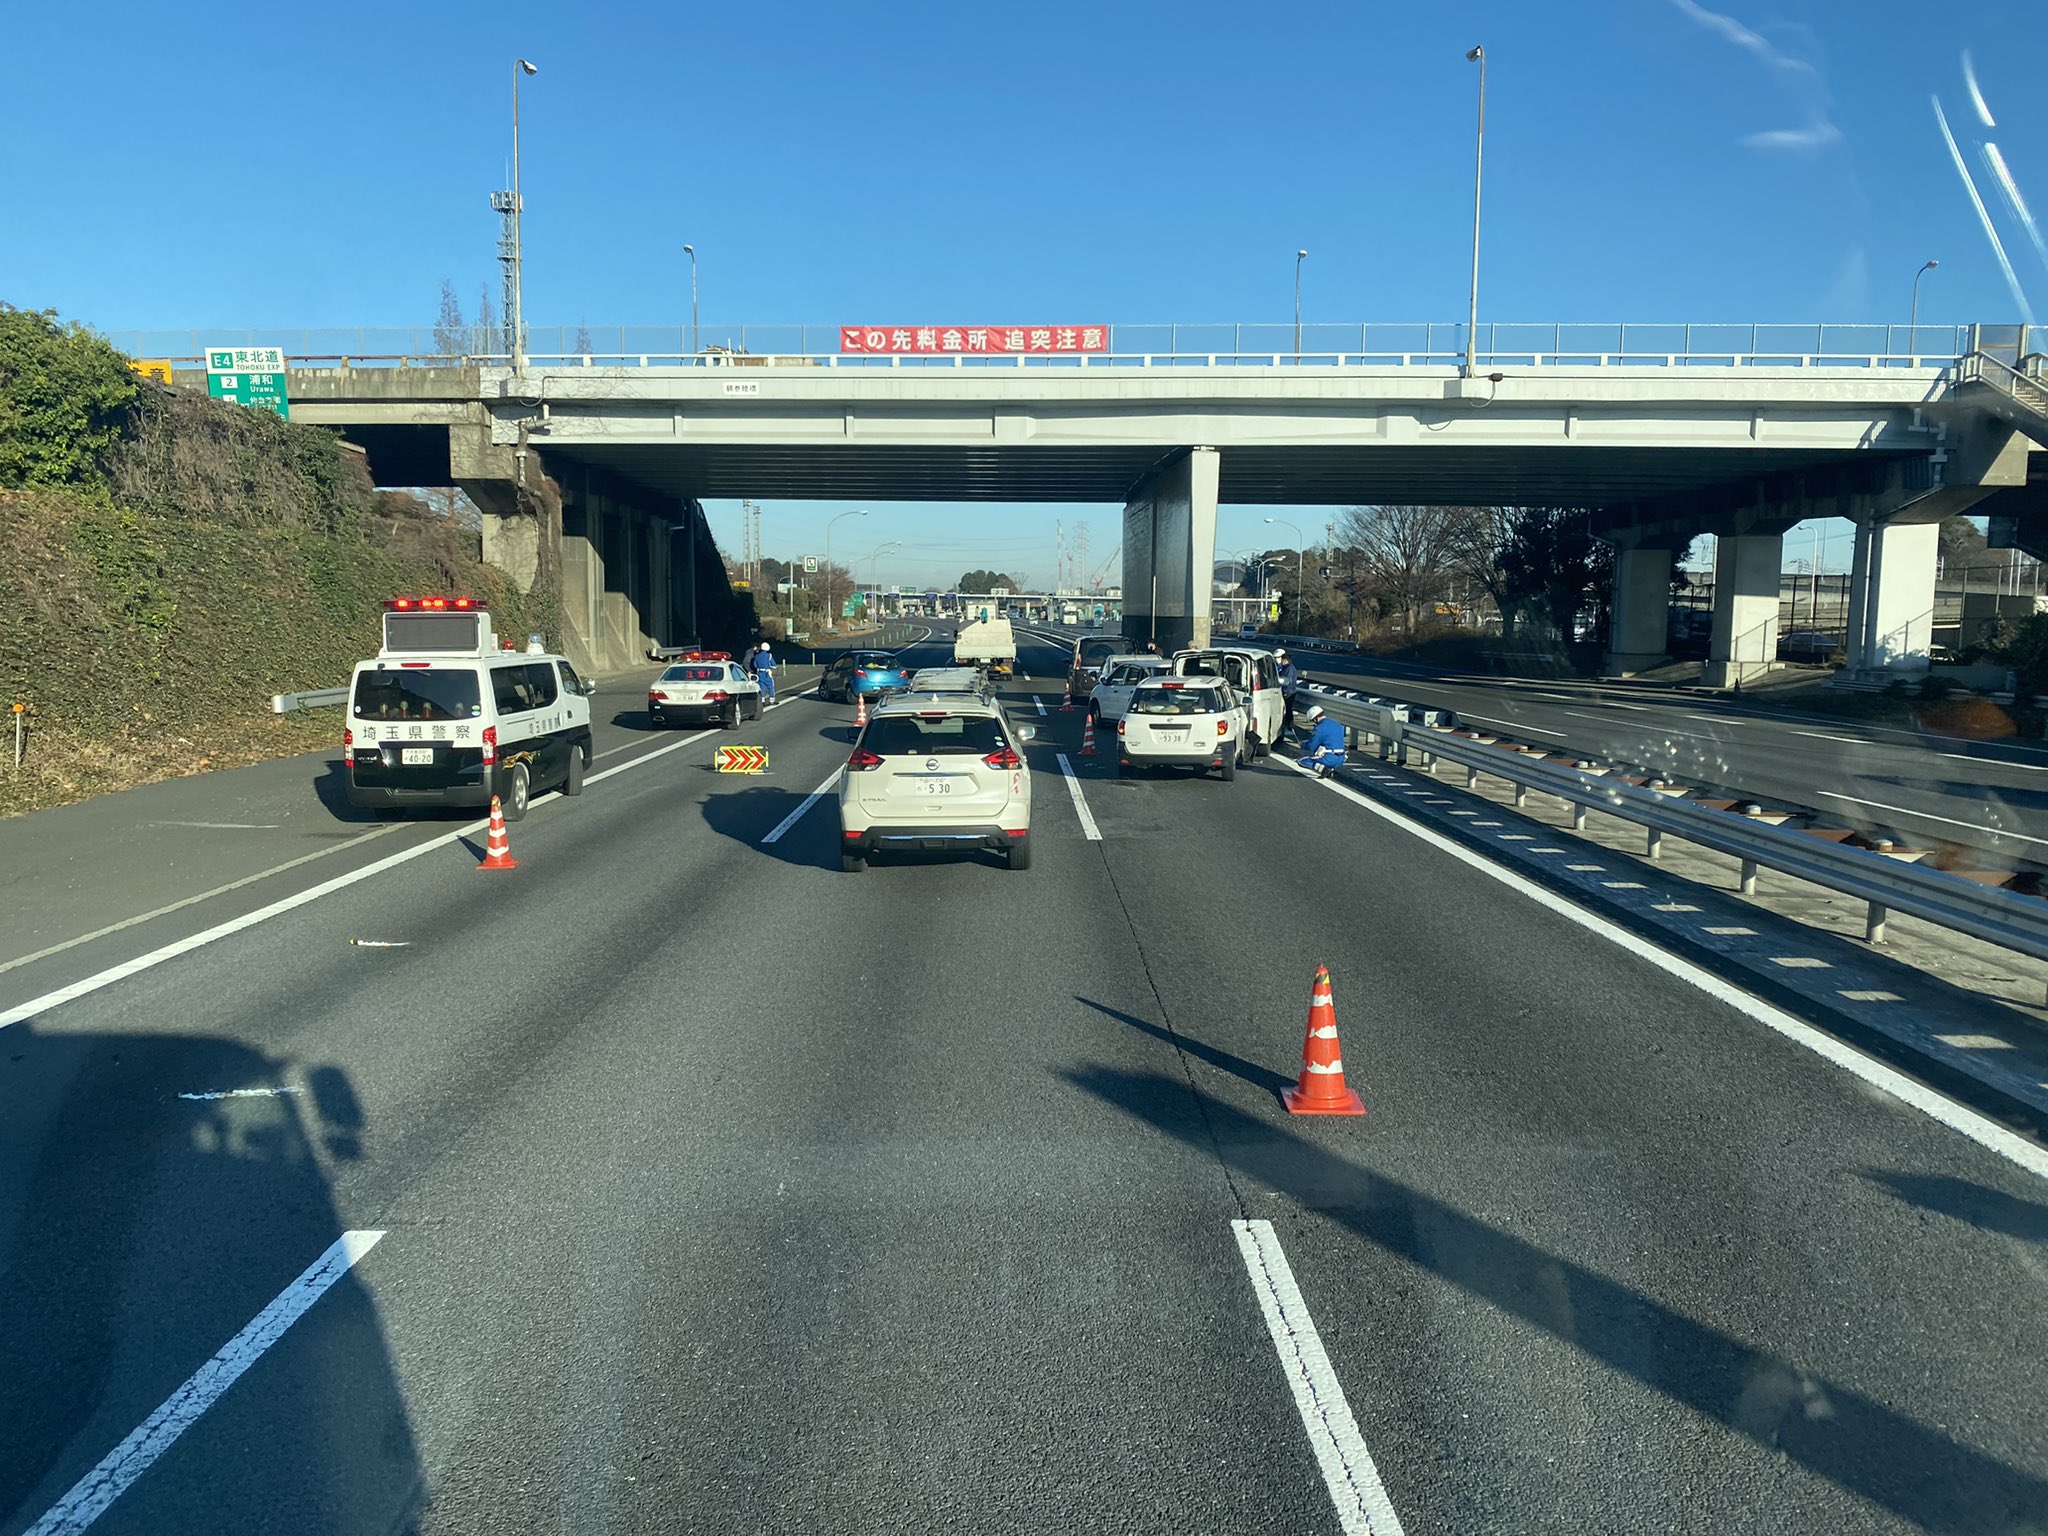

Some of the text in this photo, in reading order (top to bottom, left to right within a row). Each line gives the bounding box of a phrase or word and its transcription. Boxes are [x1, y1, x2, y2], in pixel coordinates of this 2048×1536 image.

[845, 328, 1102, 351] この先料金所 追突注意
[213, 355, 231, 366] E4
[235, 350, 279, 363] 東北道
[226, 378, 233, 387] 2
[249, 374, 274, 385] 浦和
[250, 385, 274, 393] Urawa
[362, 725, 471, 741] 埼玉県警察
